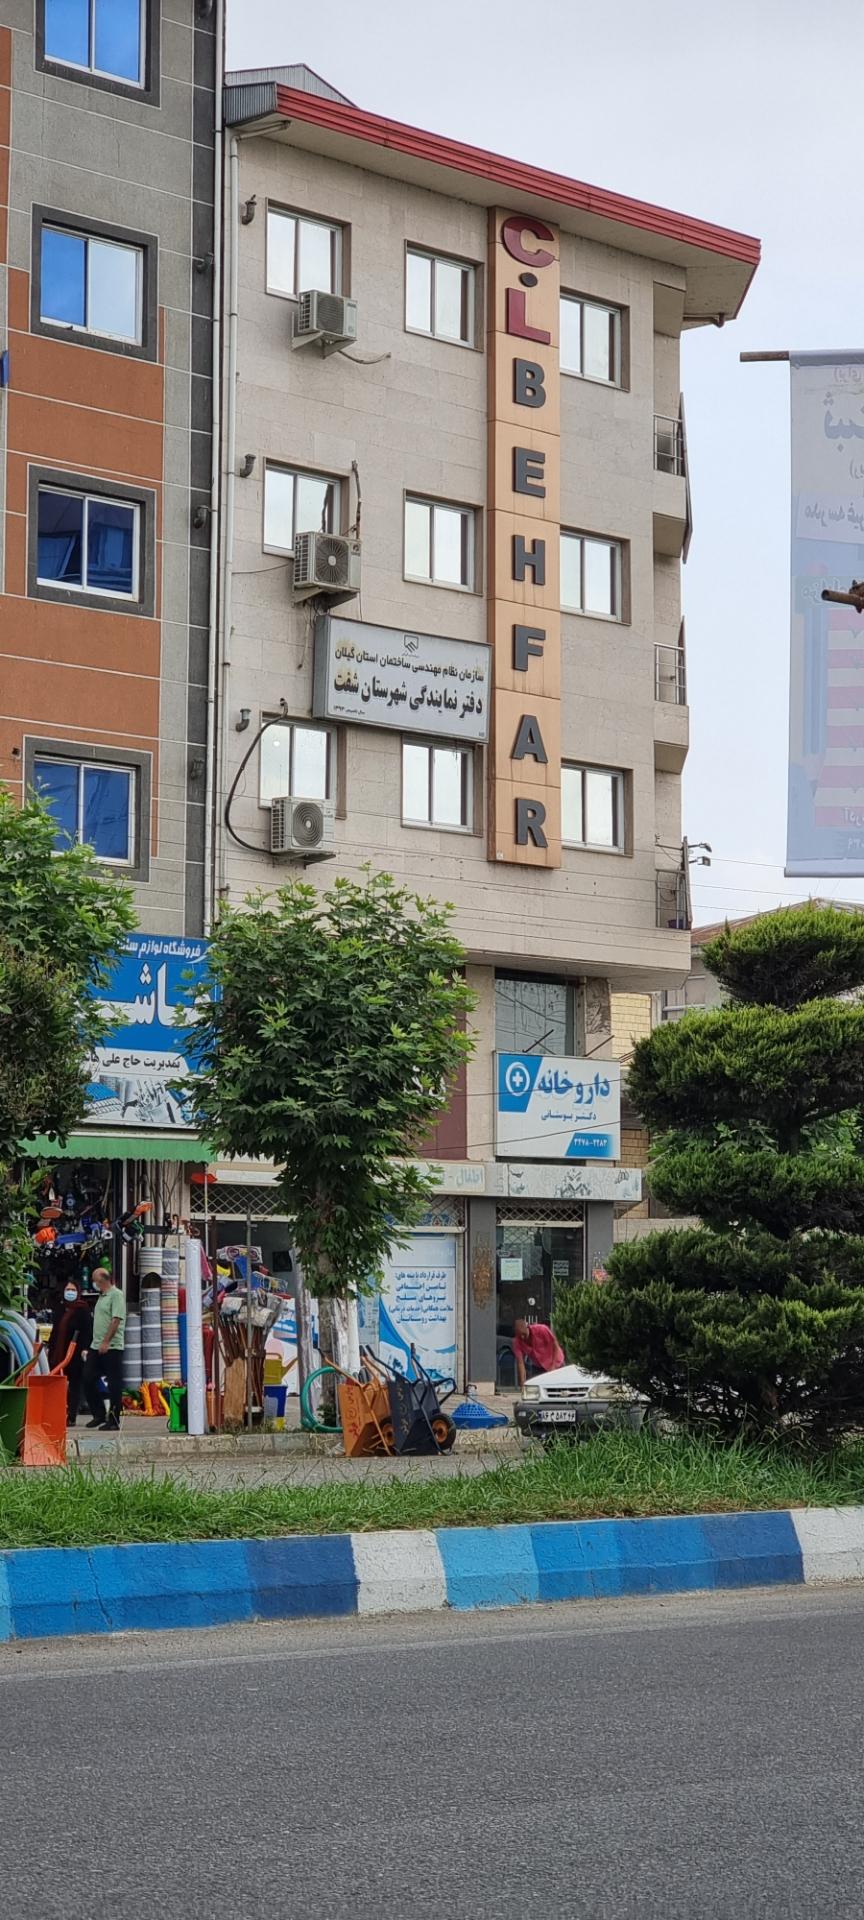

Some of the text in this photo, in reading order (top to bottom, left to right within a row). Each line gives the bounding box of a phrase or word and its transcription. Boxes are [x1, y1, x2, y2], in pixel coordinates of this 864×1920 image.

[511, 357, 548, 848] BEHFAR
[335, 647, 484, 683] سازمان نظام مهندسی ساختمان استان گیلان
[334, 671, 483, 718] دفتر نمایندگی شهرستان شفت
[138, 940, 162, 958] لوازم
[163, 940, 201, 959] فروشگاه
[102, 1053, 120, 1067] علی
[123, 1055, 141, 1069] حاج
[538, 1069, 611, 1104] داروخانه
[575, 1112, 597, 1123] دکتر
